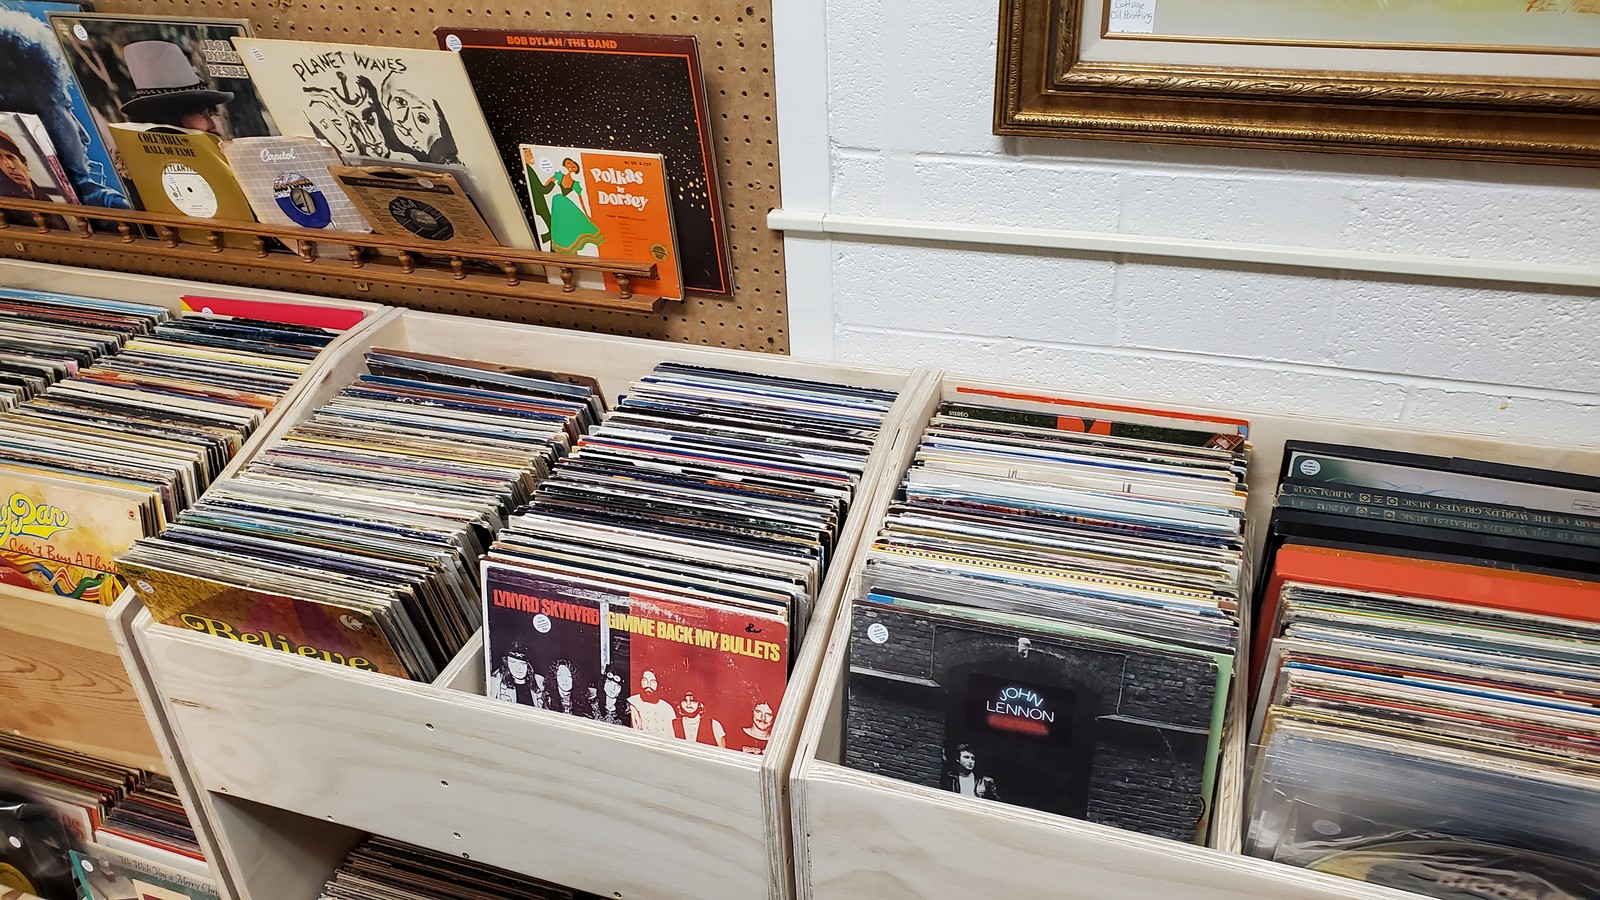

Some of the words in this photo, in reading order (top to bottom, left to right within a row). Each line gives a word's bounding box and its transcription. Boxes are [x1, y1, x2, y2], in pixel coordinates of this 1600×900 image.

[1111, 10, 1121, 19] Oil
[1124, 10, 1153, 24] Painting
[205, 39, 231, 51] BOB
[505, 35, 527, 46] BOB
[587, 38, 618, 49] BAND
[208, 65, 248, 78] DESIRE
[292, 51, 346, 82] PLANET
[353, 51, 408, 72] WAVES
[137, 132, 182, 146] COLUMBIA
[143, 145, 165, 154] HALL
[164, 147, 174, 156] OF
[175, 147, 197, 158] FAME
[260, 148, 296, 162] Capitol
[164, 163, 197, 174] ATLANTI
[590, 168, 644, 185] Polkas
[597, 190, 649, 212] Dorsey
[1320, 487, 1354, 499] ALBUM
[1317, 502, 1350, 513] ALBUM
[1402, 499, 1431, 509] MUSIC
[1434, 503, 1482, 515] GREATEST
[8, 493, 69, 535] Dan
[1399, 513, 1428, 522] MUSIC
[1532, 514, 1553, 523] THE
[1433, 517, 1480, 529] GREATEST
[9, 537, 44, 557] Can't
[46, 544, 71, 567] Buy
[75, 551, 84, 568] A
[493, 588, 540, 614] LYNYRD
[541, 598, 600, 626] SKYNYRD
[180, 613, 373, 672] Believe
[607, 611, 656, 637] GIMME
[656, 621, 695, 644] BACK
[695, 628, 720, 649] MY
[719, 633, 781, 662] BULLETS
[999, 687, 1044, 707] JOHN
[986, 700, 1055, 723] LENNON
[174, 875, 201, 891] Merry
